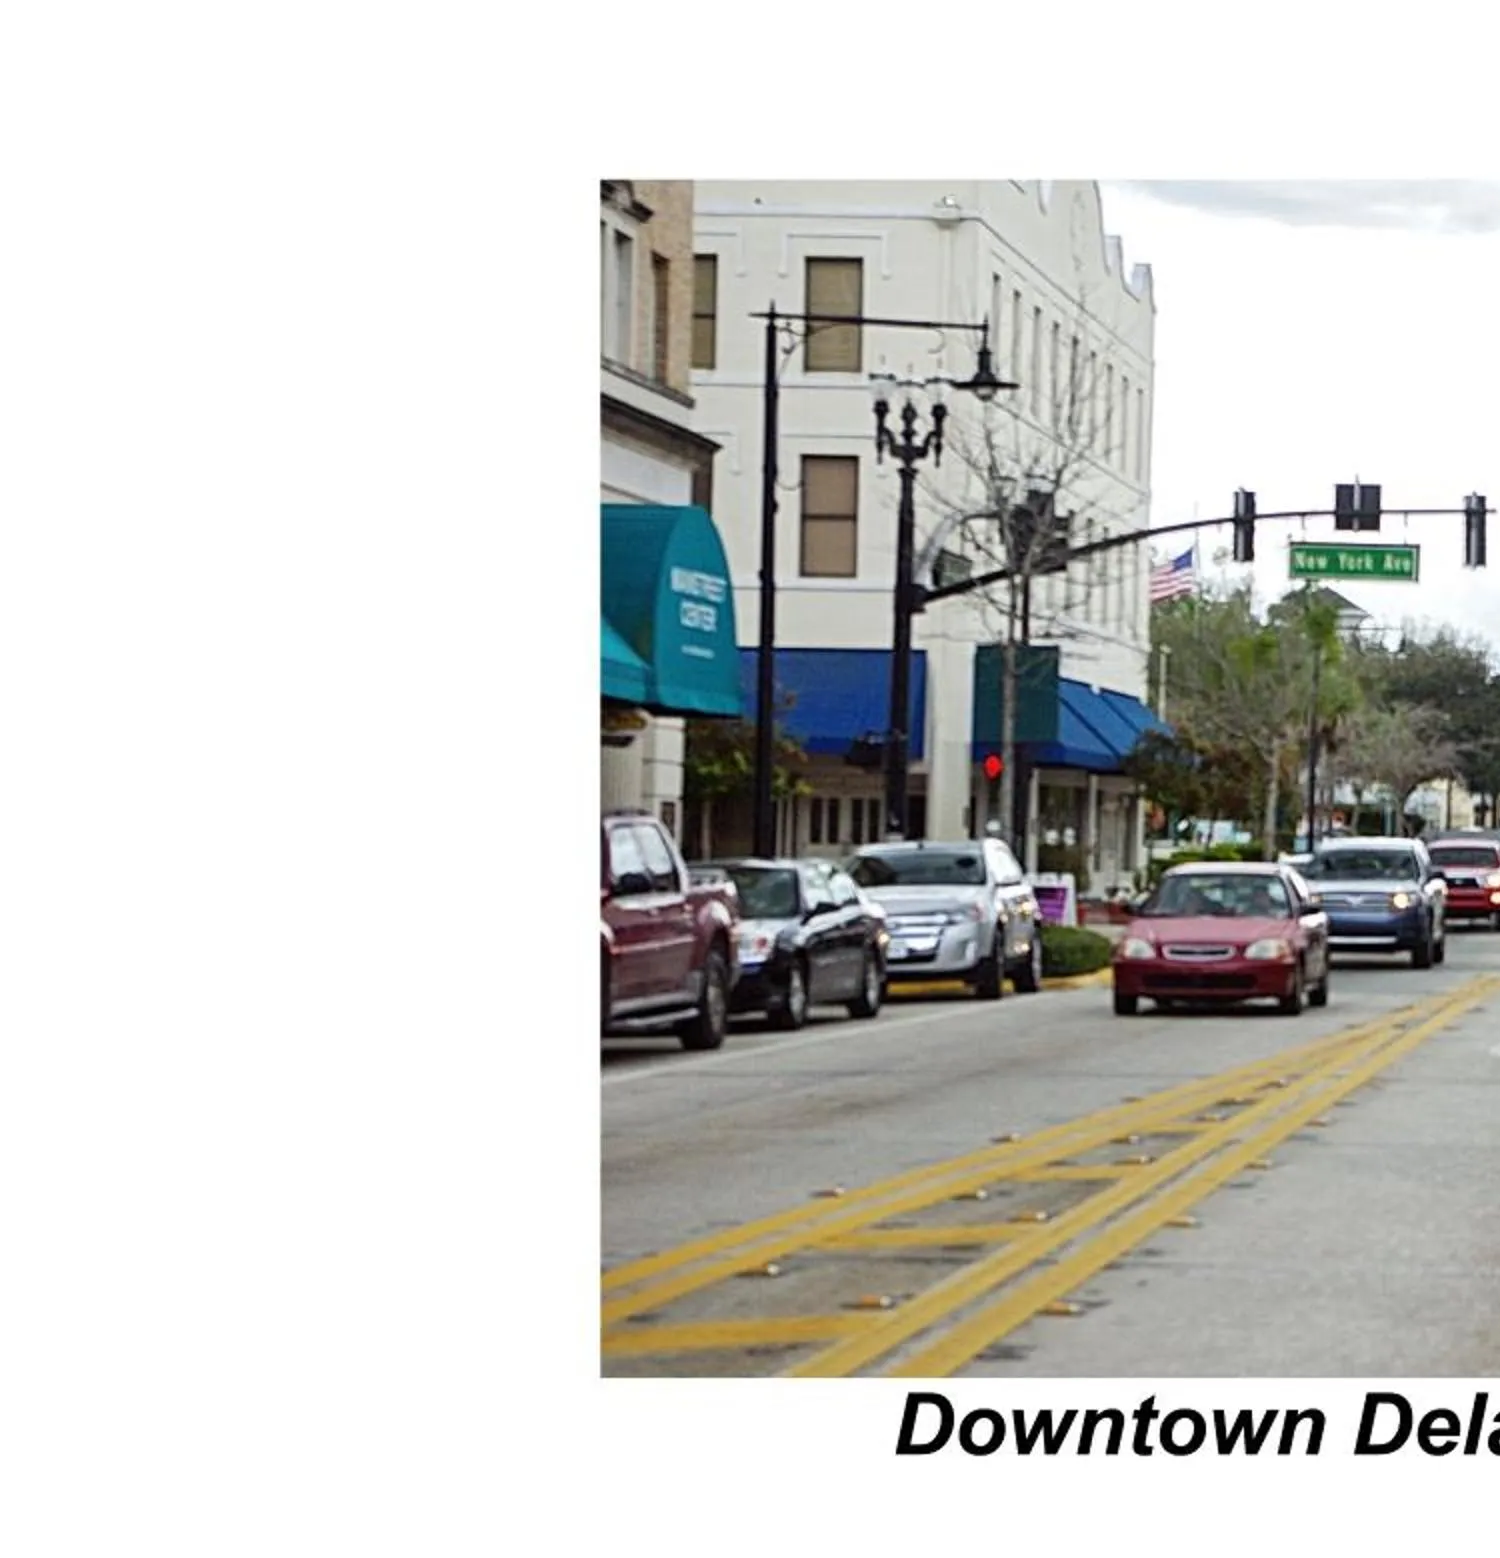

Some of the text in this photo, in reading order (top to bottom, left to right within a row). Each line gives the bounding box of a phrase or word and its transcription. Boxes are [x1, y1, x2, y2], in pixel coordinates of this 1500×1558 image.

[1294, 551, 1411, 572] New York Ave
